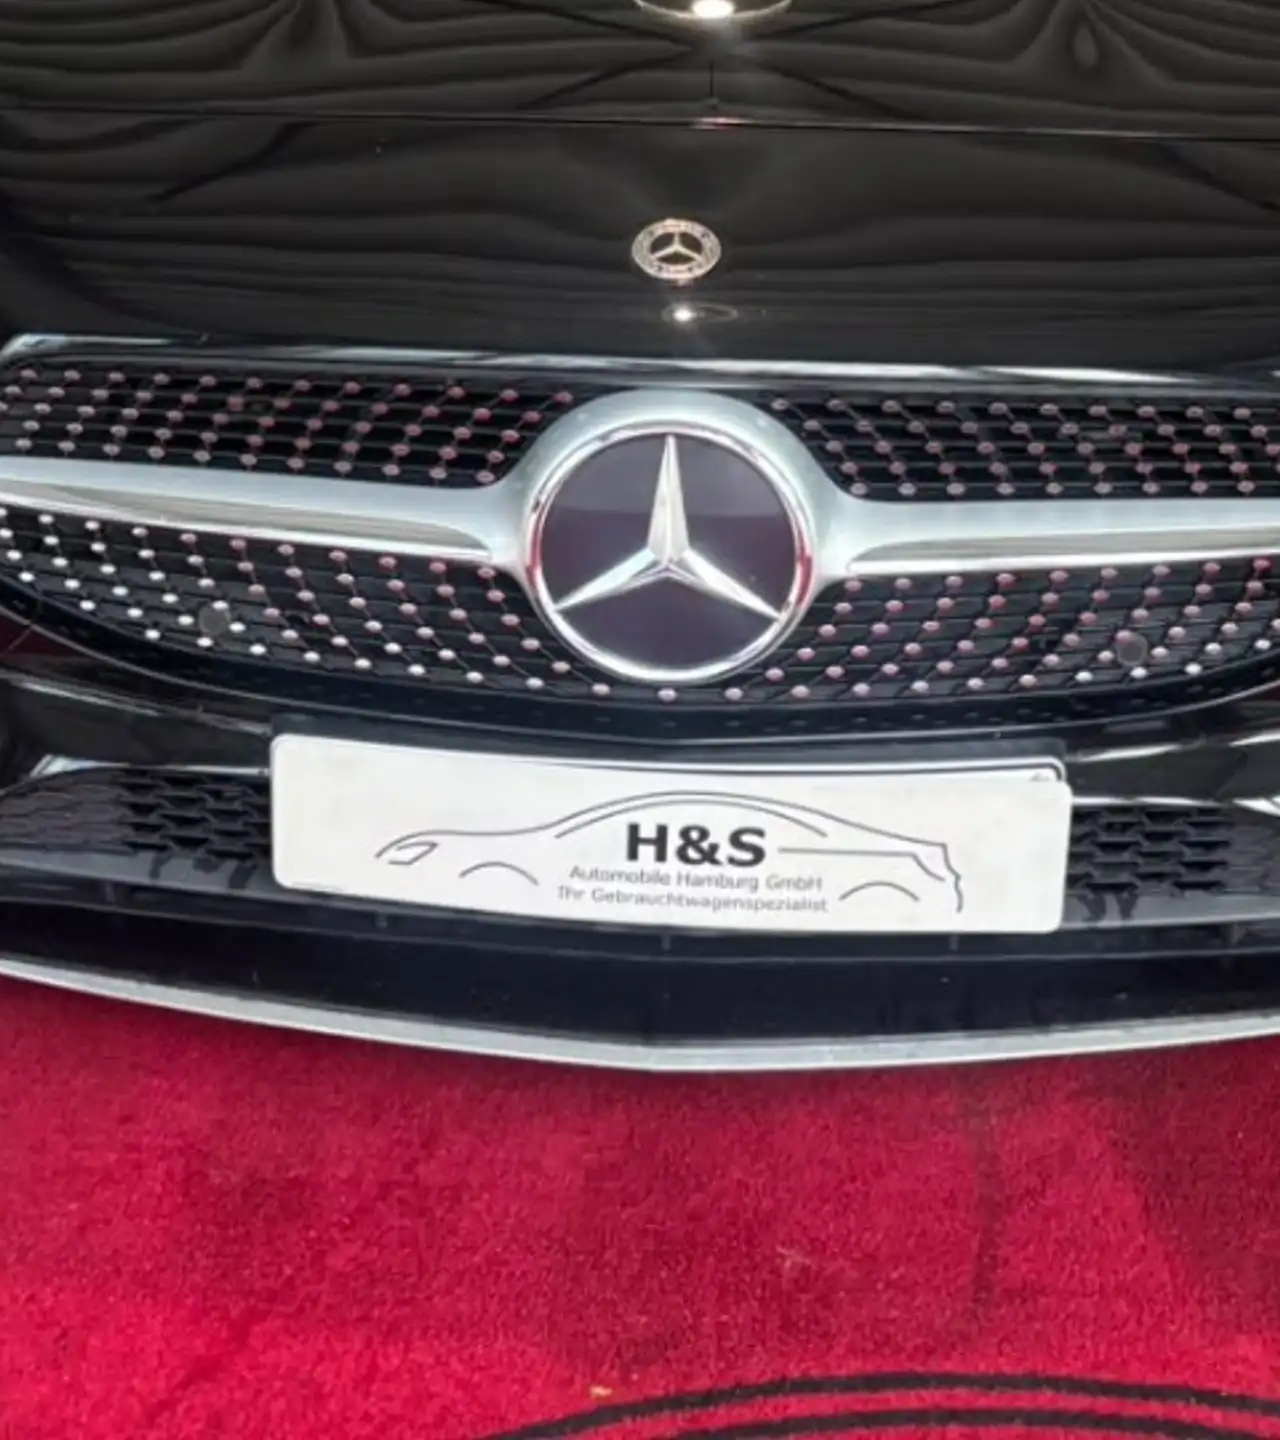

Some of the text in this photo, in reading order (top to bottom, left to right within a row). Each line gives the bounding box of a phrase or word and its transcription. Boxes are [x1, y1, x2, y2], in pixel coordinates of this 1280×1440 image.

[626, 822, 767, 868] H&S
[569, 865, 823, 893] Automobile Hamburg GmbH
[558, 885, 828, 913] Ihr Gebrauchtwagenspezialist
